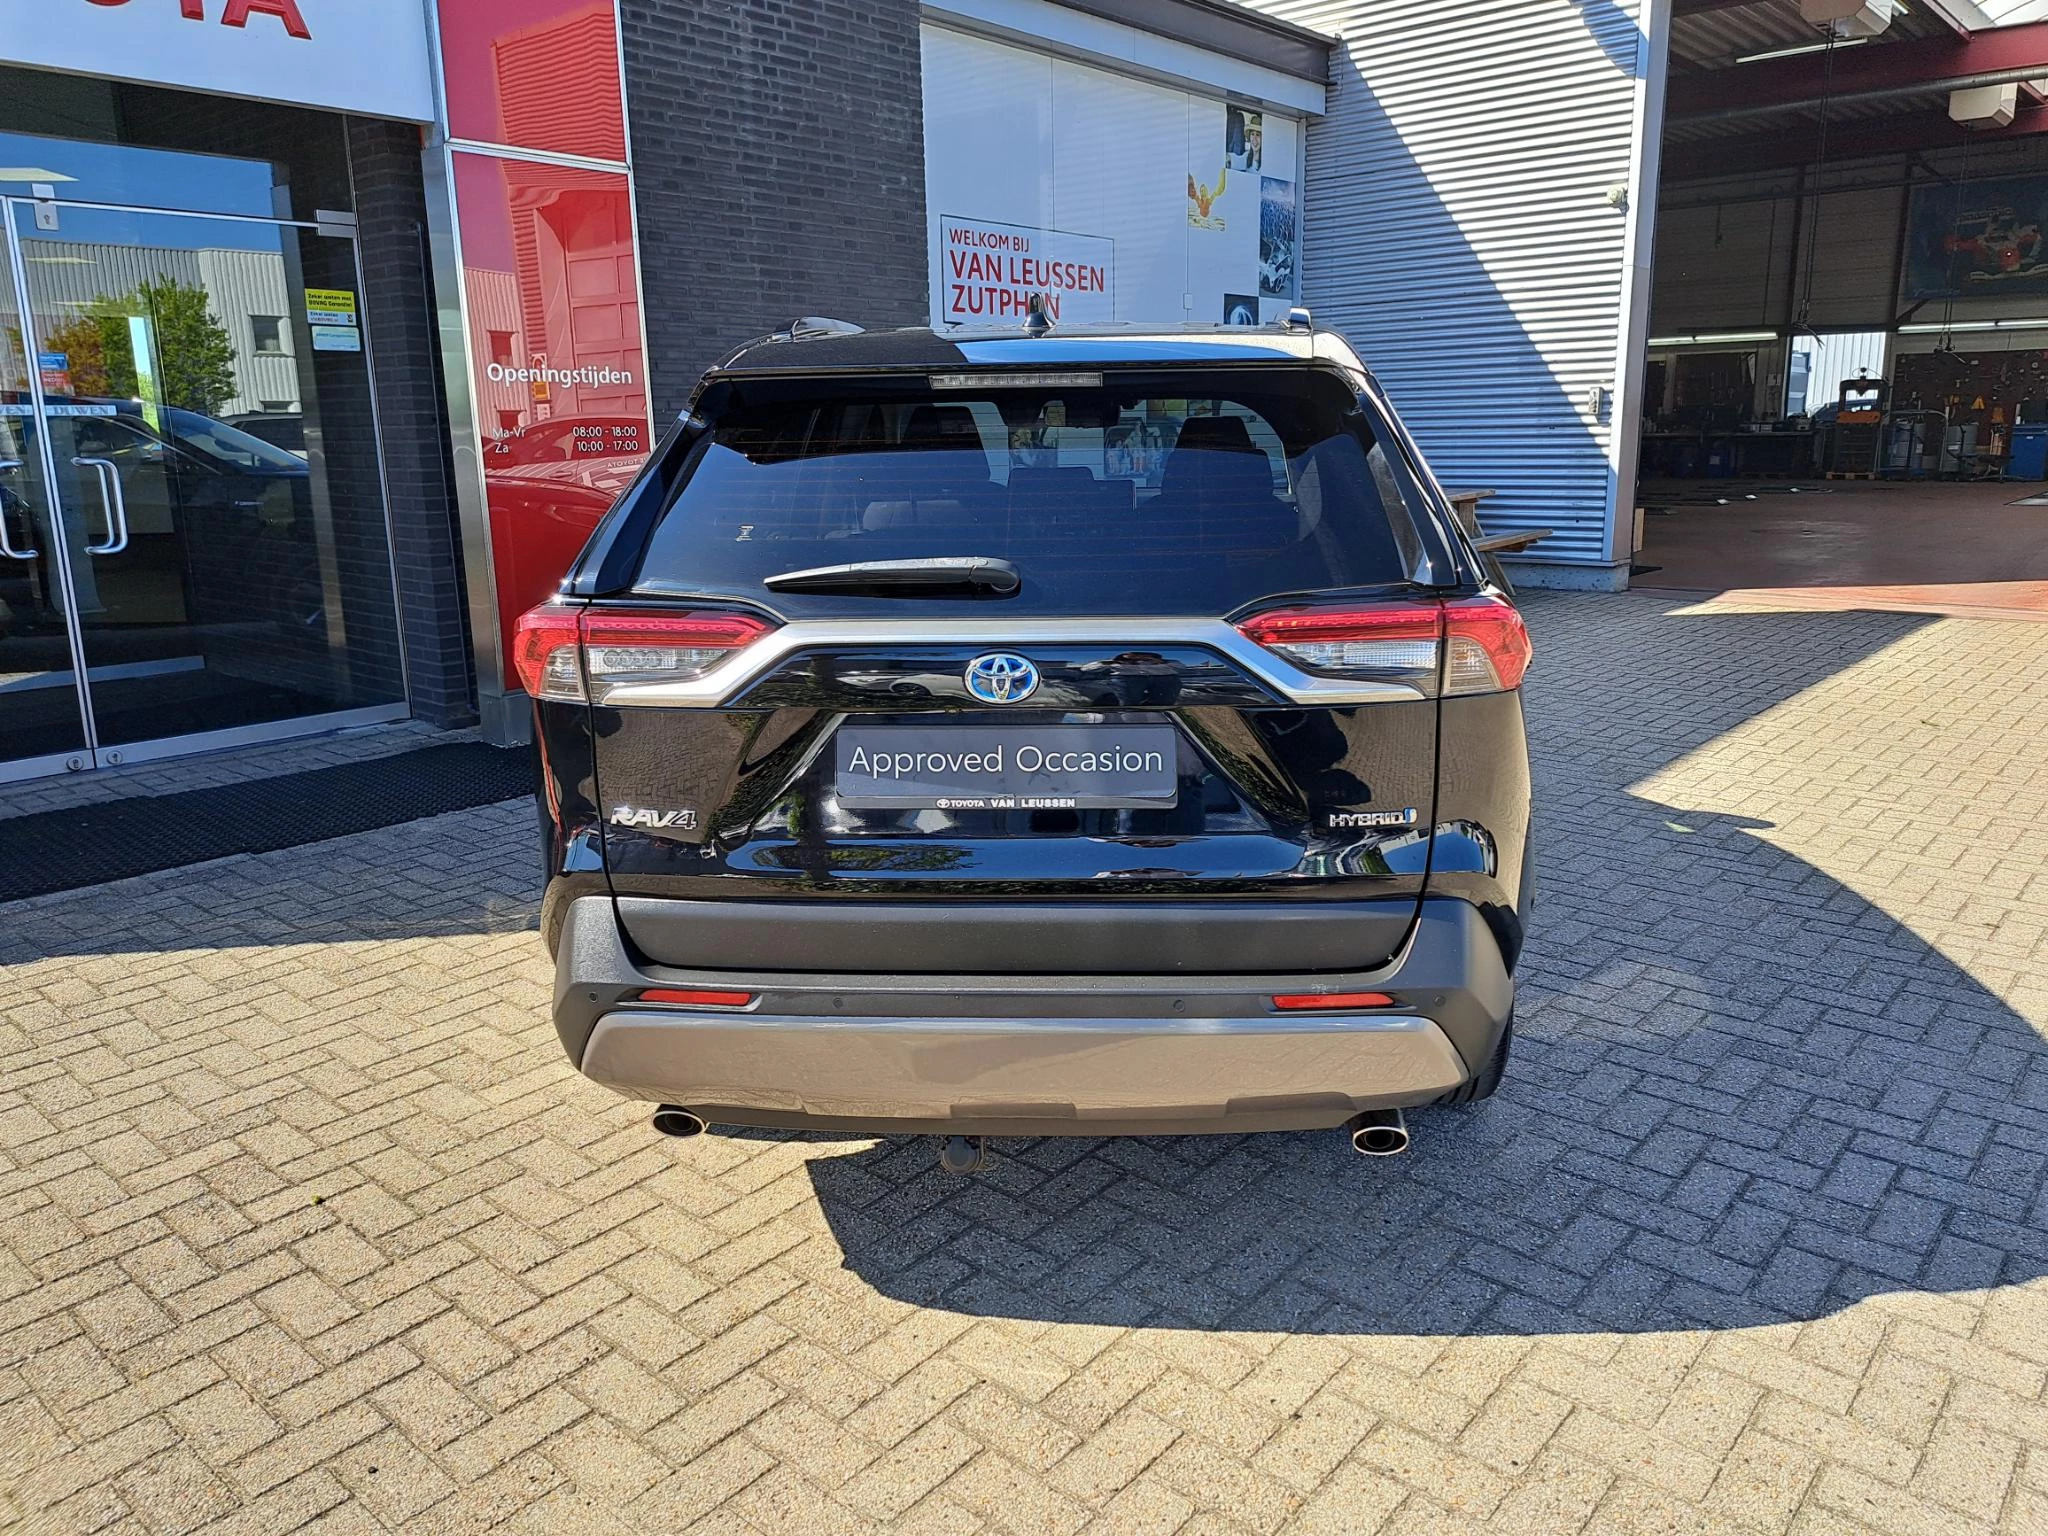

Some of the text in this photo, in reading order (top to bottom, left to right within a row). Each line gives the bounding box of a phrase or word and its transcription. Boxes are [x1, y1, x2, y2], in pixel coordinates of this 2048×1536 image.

[949, 228, 1030, 253] WELKOM BIJ
[949, 249, 1104, 292] VAN LEUSSEN
[951, 284, 1060, 320] ZUTPHN
[486, 363, 632, 389] Openingstijden
[54, 405, 109, 415] DUWEN
[492, 427, 526, 438] Ma-Vr
[572, 426, 603, 437] 08:00
[612, 426, 637, 437] 18:00
[495, 442, 509, 453] Za
[576, 441, 604, 452] 10:00
[613, 440, 638, 451] 17:00
[848, 744, 1164, 779] Approved Occasion
[950, 798, 1076, 808] TOYOTA VAN LEUSSEN
[609, 805, 698, 831] RAV4
[1328, 812, 1405, 828] HYBRID
